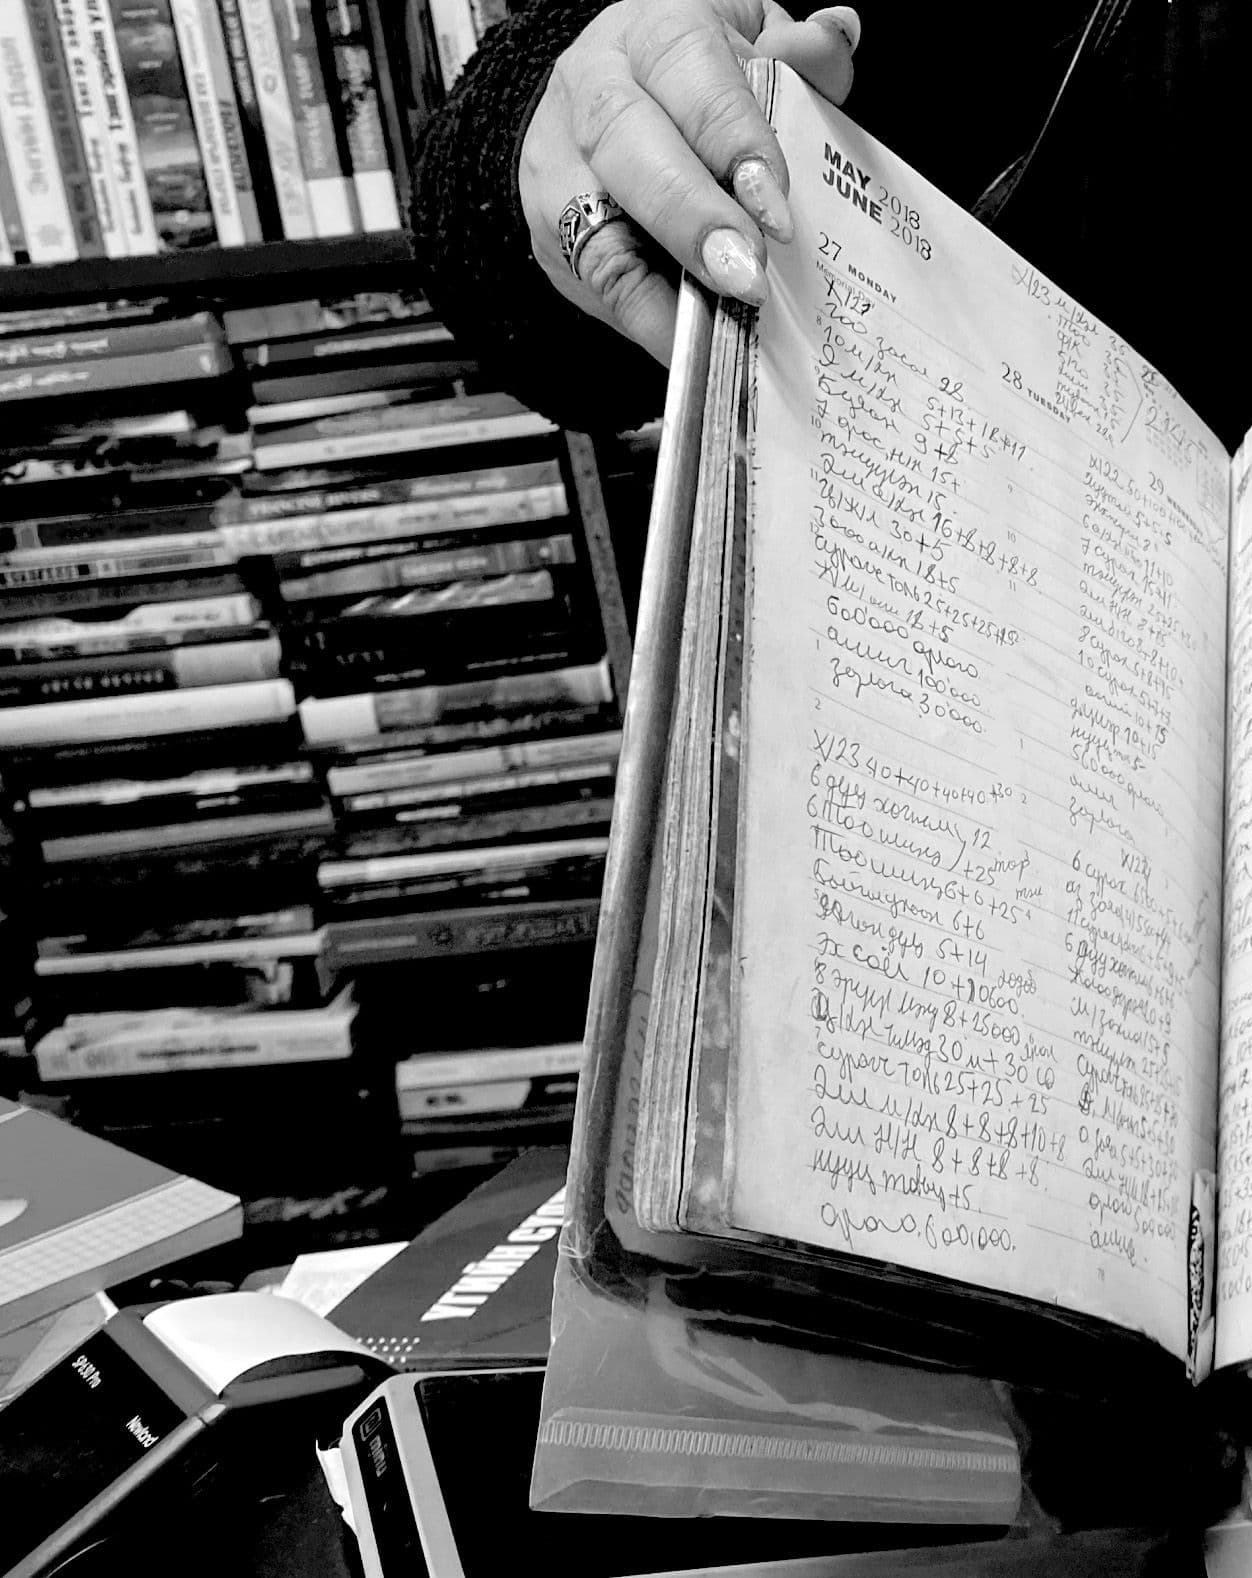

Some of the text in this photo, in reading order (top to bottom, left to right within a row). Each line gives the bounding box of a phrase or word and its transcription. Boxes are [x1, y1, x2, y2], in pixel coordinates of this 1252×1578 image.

[822, 169, 932, 261] JUNE 2018
[824, 142, 920, 230] MAY 2018
[817, 232, 897, 303] 27 MONDAY
[1001, 361, 1071, 424] 28 TUESDAY
[1149, 471, 1164, 496] 29
[126, 1415, 159, 1448] Newland
